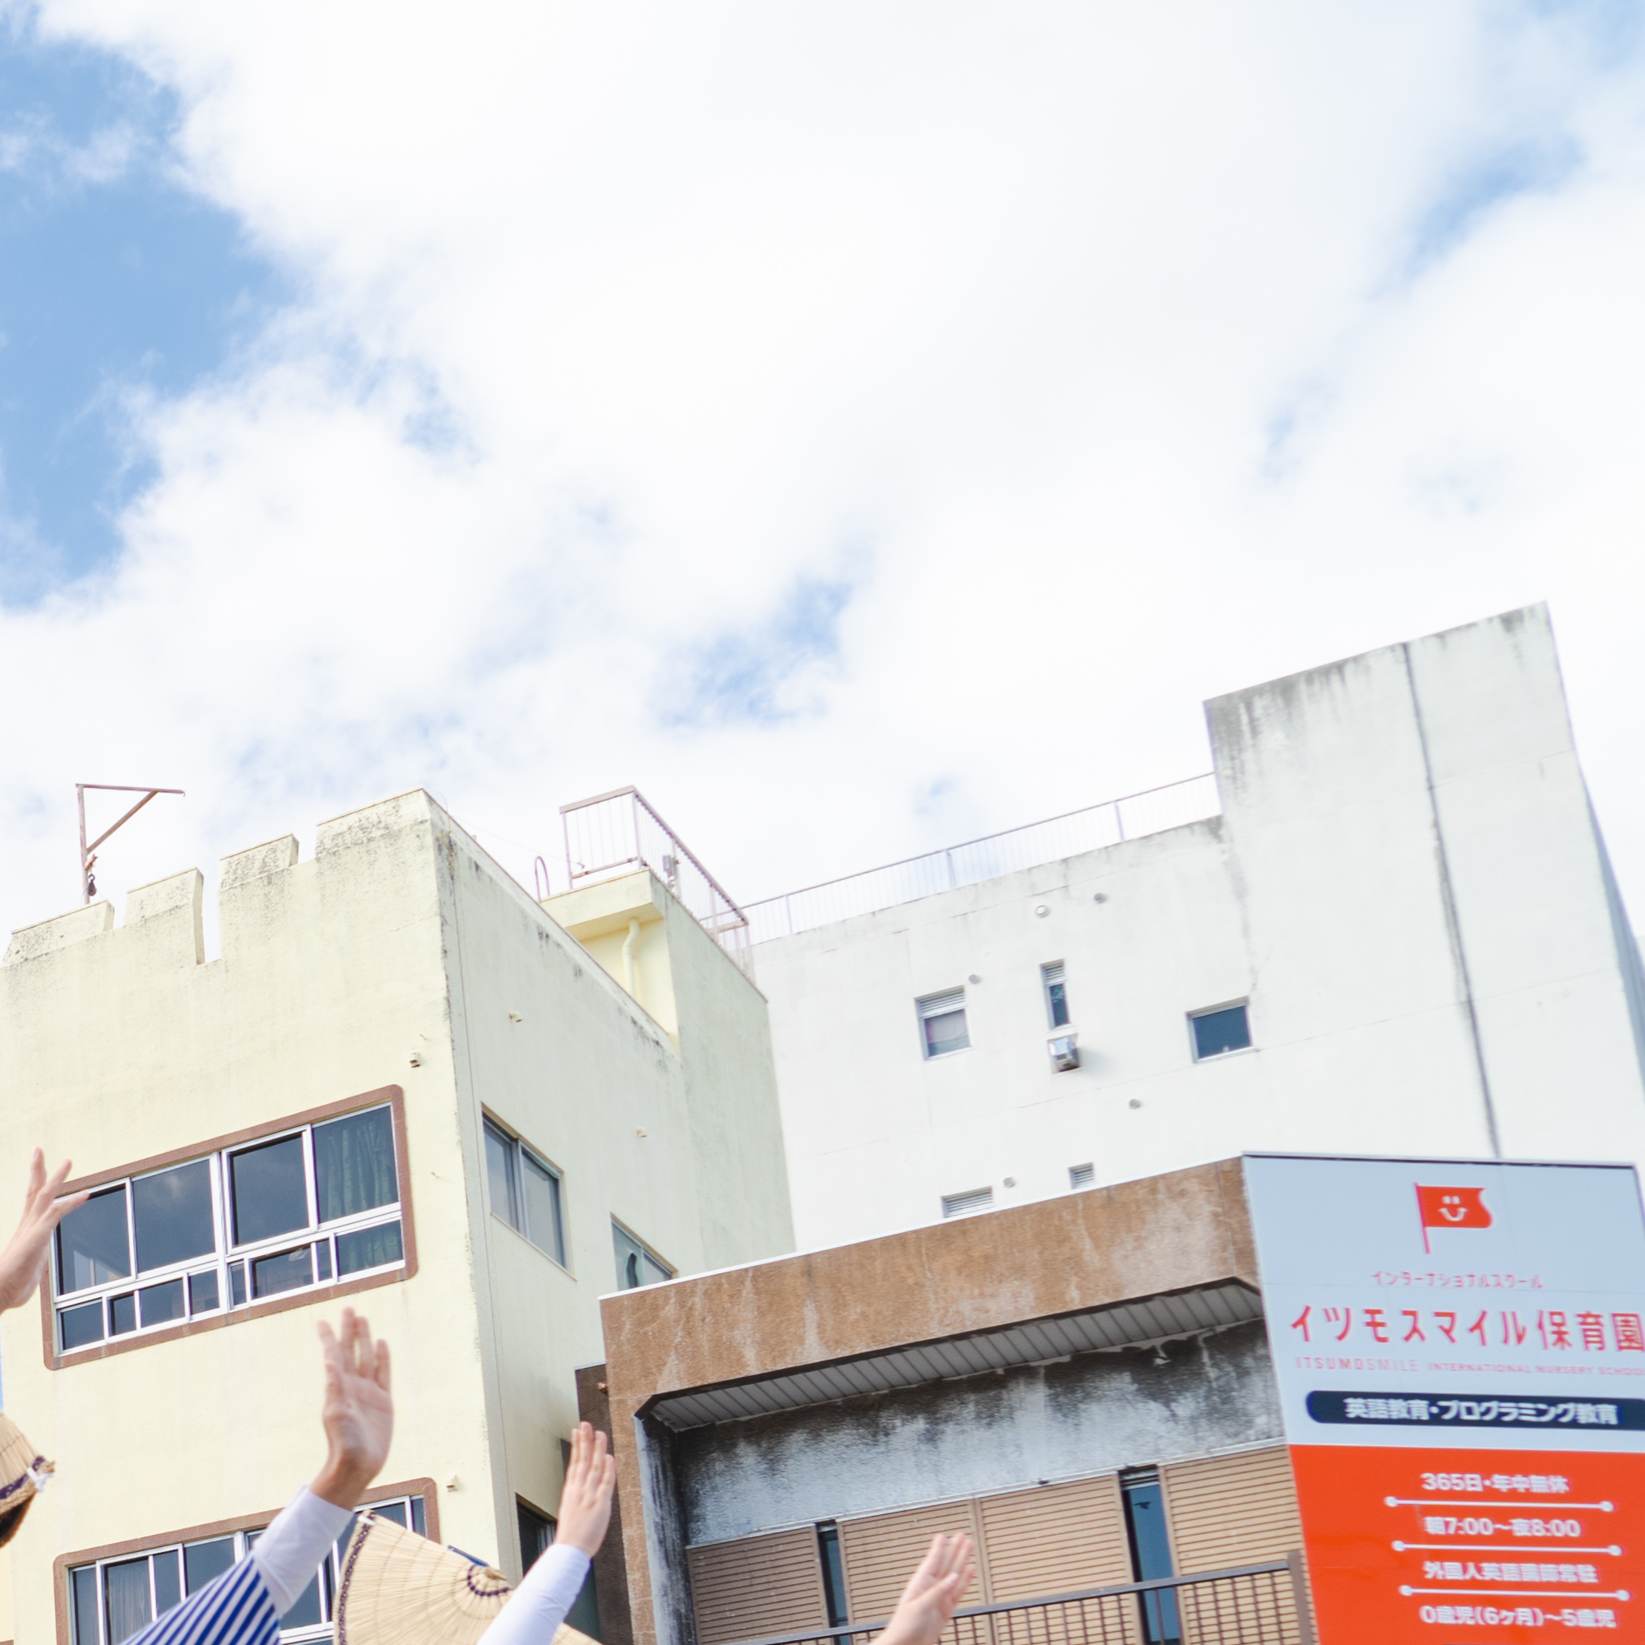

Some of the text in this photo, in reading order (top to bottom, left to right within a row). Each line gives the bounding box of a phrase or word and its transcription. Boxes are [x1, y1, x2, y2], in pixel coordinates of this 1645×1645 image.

[1372, 1270, 1545, 1289] インターナショナルスクール
[1291, 1304, 1645, 1352] イツモスマイル保育園
[1429, 1362, 1531, 1374] INTERNATIONAL
[1537, 1365, 1594, 1375] NURSERY
[1599, 1367, 1645, 1376] SCHOO
[1343, 1397, 1619, 1425] 英語教育・プログラミング教育
[1421, 1472, 1570, 1493] 365日・年中無休
